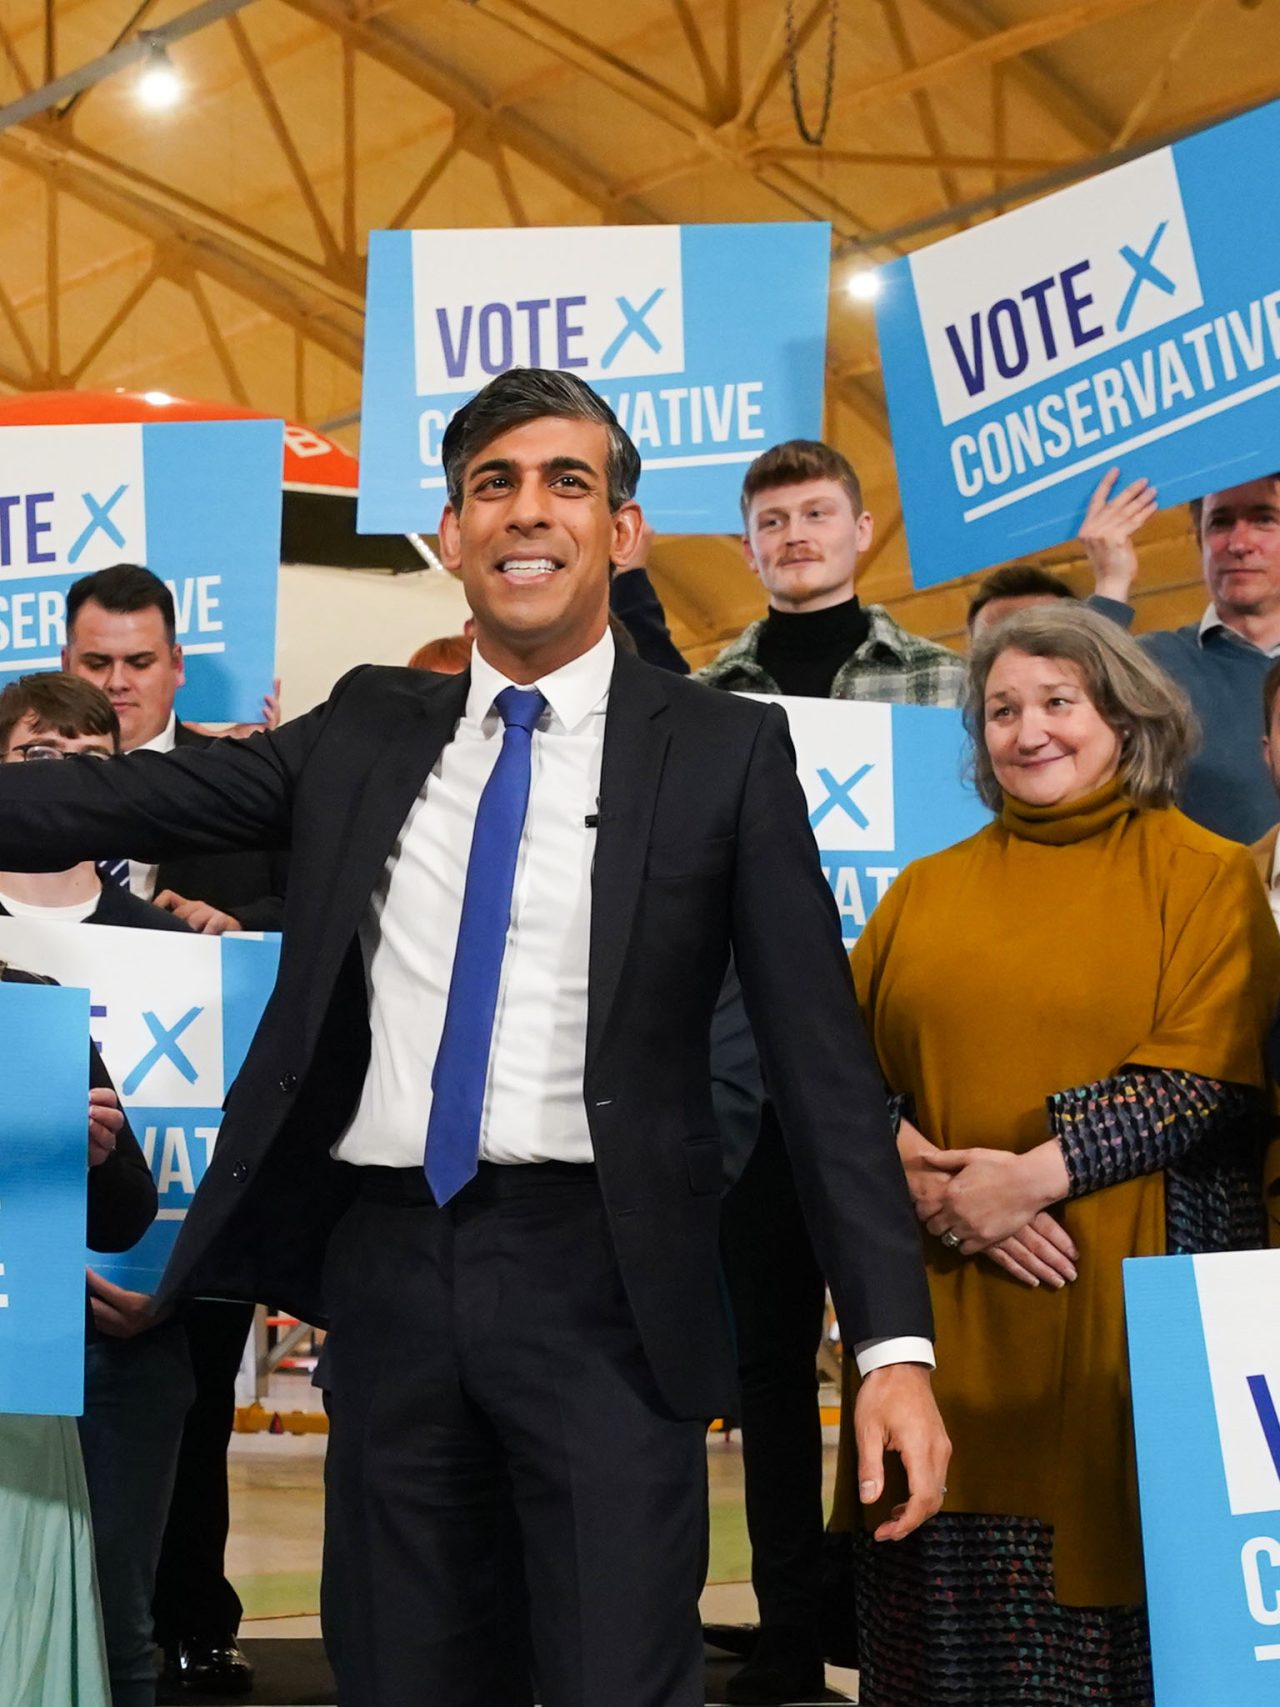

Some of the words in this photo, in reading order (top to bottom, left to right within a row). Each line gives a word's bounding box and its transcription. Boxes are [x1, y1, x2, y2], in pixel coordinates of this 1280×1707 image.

[436, 295, 588, 378] VOTE
[945, 259, 1105, 397] VOTE
[419, 382, 765, 467] CATIVE
